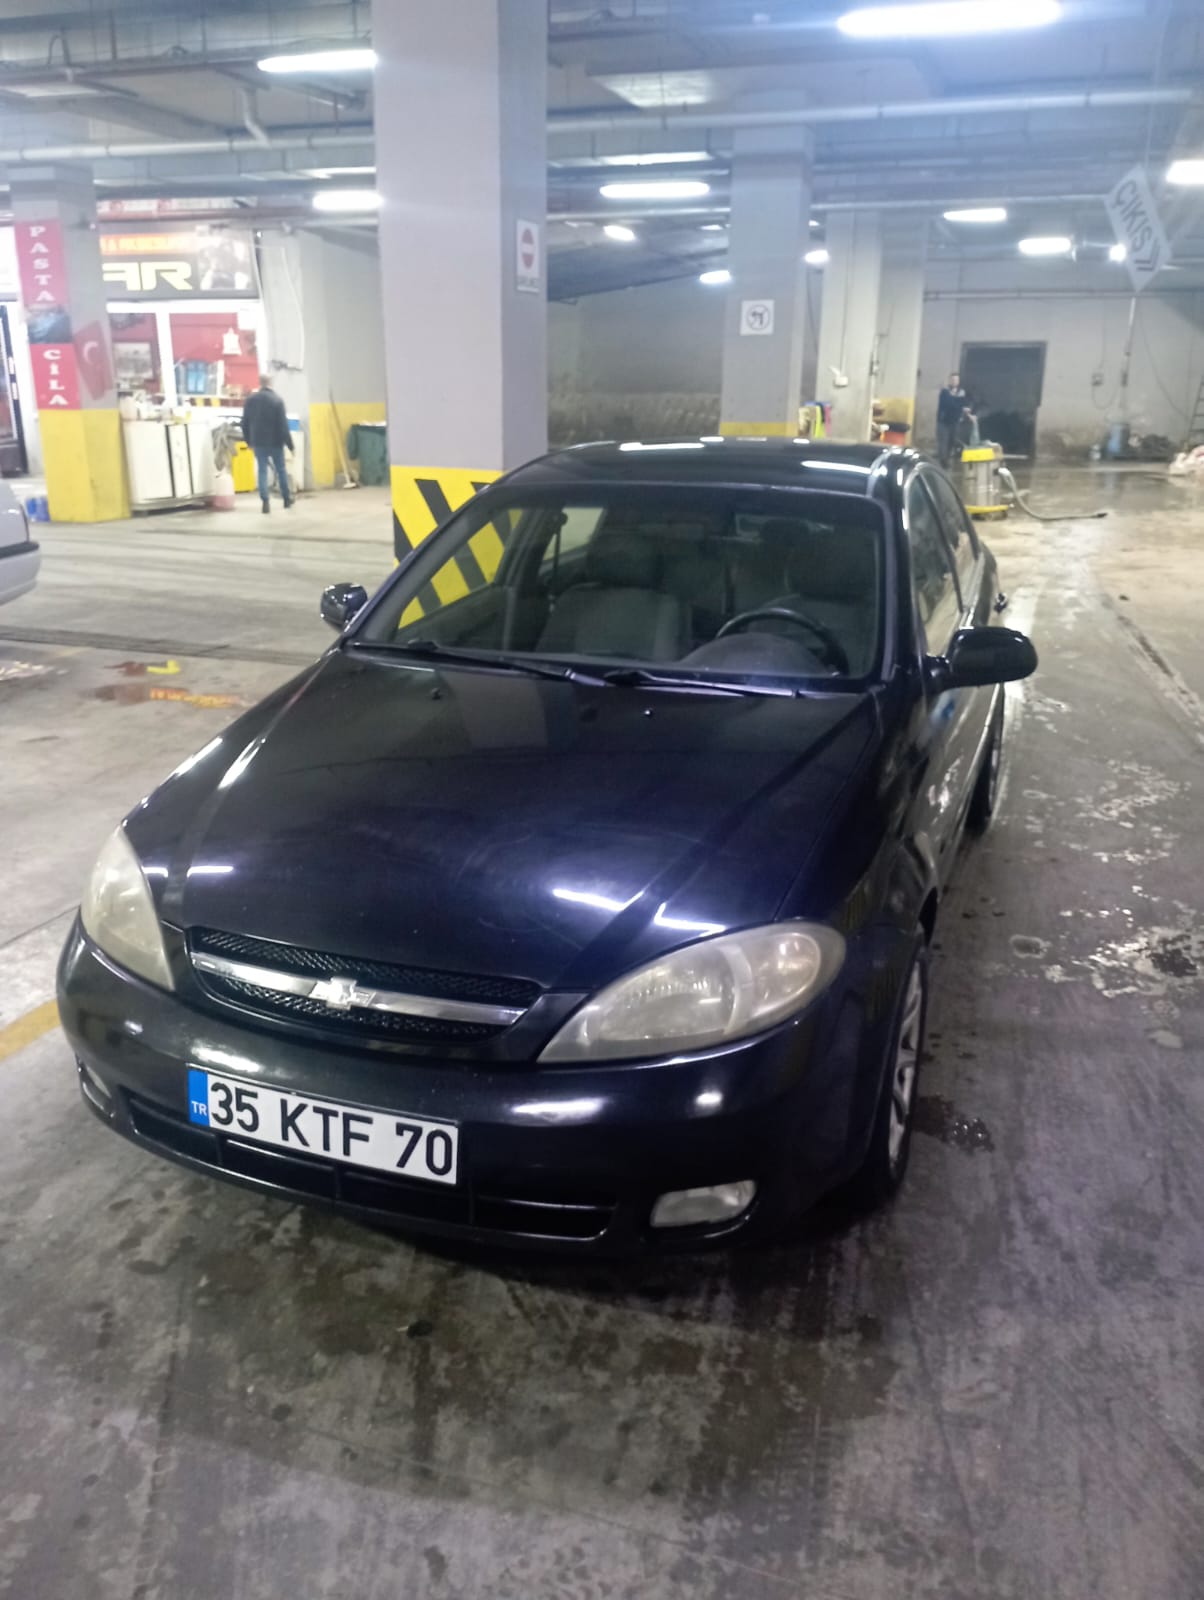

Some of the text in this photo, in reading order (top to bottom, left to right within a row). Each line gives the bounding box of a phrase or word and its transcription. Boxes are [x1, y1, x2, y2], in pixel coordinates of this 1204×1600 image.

[29, 225, 56, 302] PASTA
[191, 1082, 453, 1176] TR 35 KTF 70
